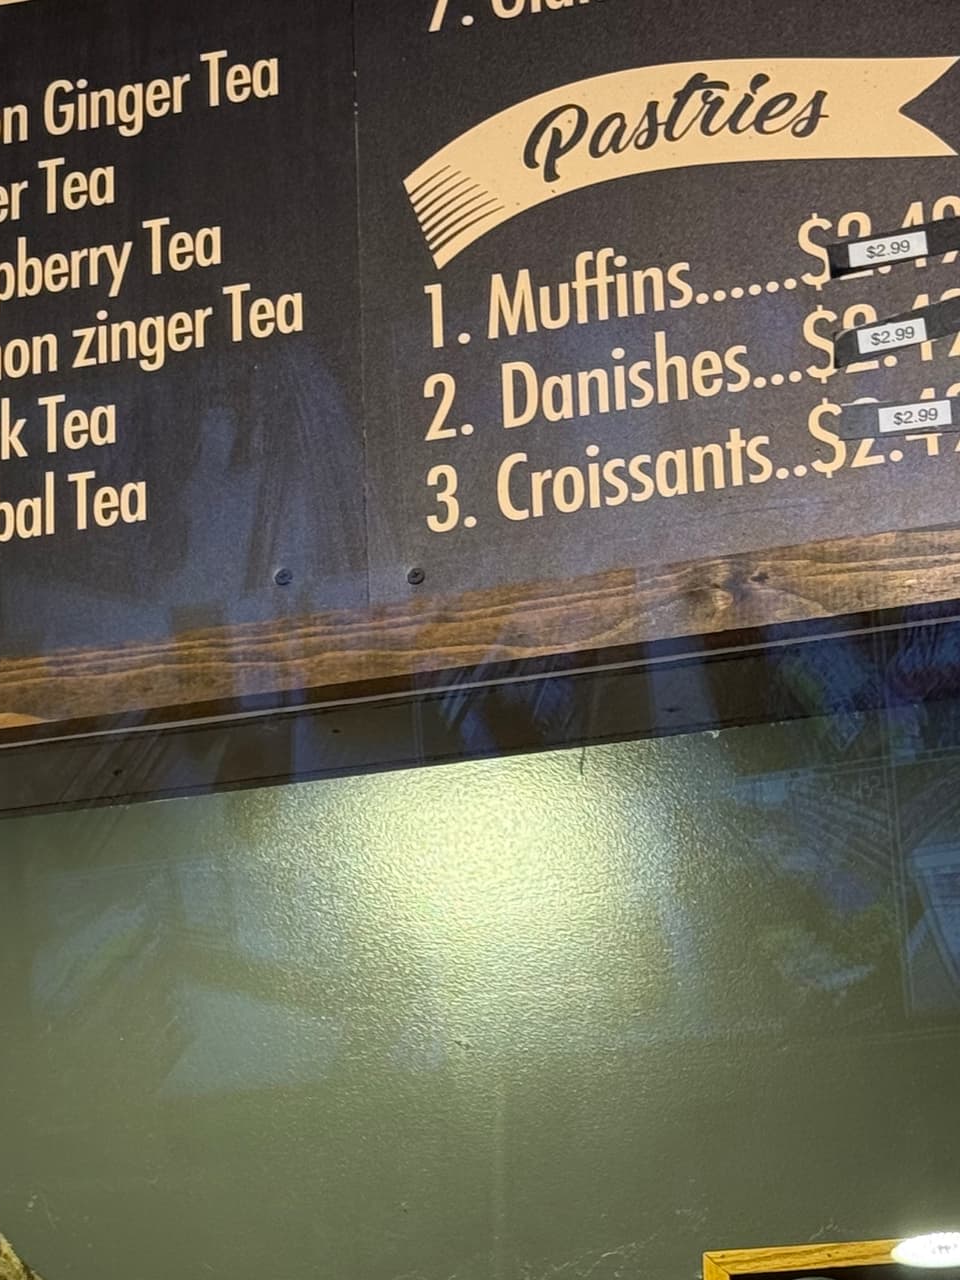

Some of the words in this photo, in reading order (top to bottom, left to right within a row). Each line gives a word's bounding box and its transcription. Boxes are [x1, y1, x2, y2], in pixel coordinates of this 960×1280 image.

[44, 74, 190, 136] Ginger
[200, 50, 278, 106] Tea
[524, 73, 828, 182] Pastries
[38, 158, 114, 213] Tea
[143, 217, 221, 274] Tea
[866, 240, 911, 260] $2.99
[72, 307, 212, 371] zinger
[223, 283, 303, 341] Tea
[424, 284, 471, 348] 1.
[870, 326, 916, 347] $2.99
[38, 394, 115, 452] Tea
[424, 373, 474, 441] 2.
[893, 407, 939, 426] $2.99
[68, 471, 146, 530] Tea
[427, 465, 477, 532] 3.
